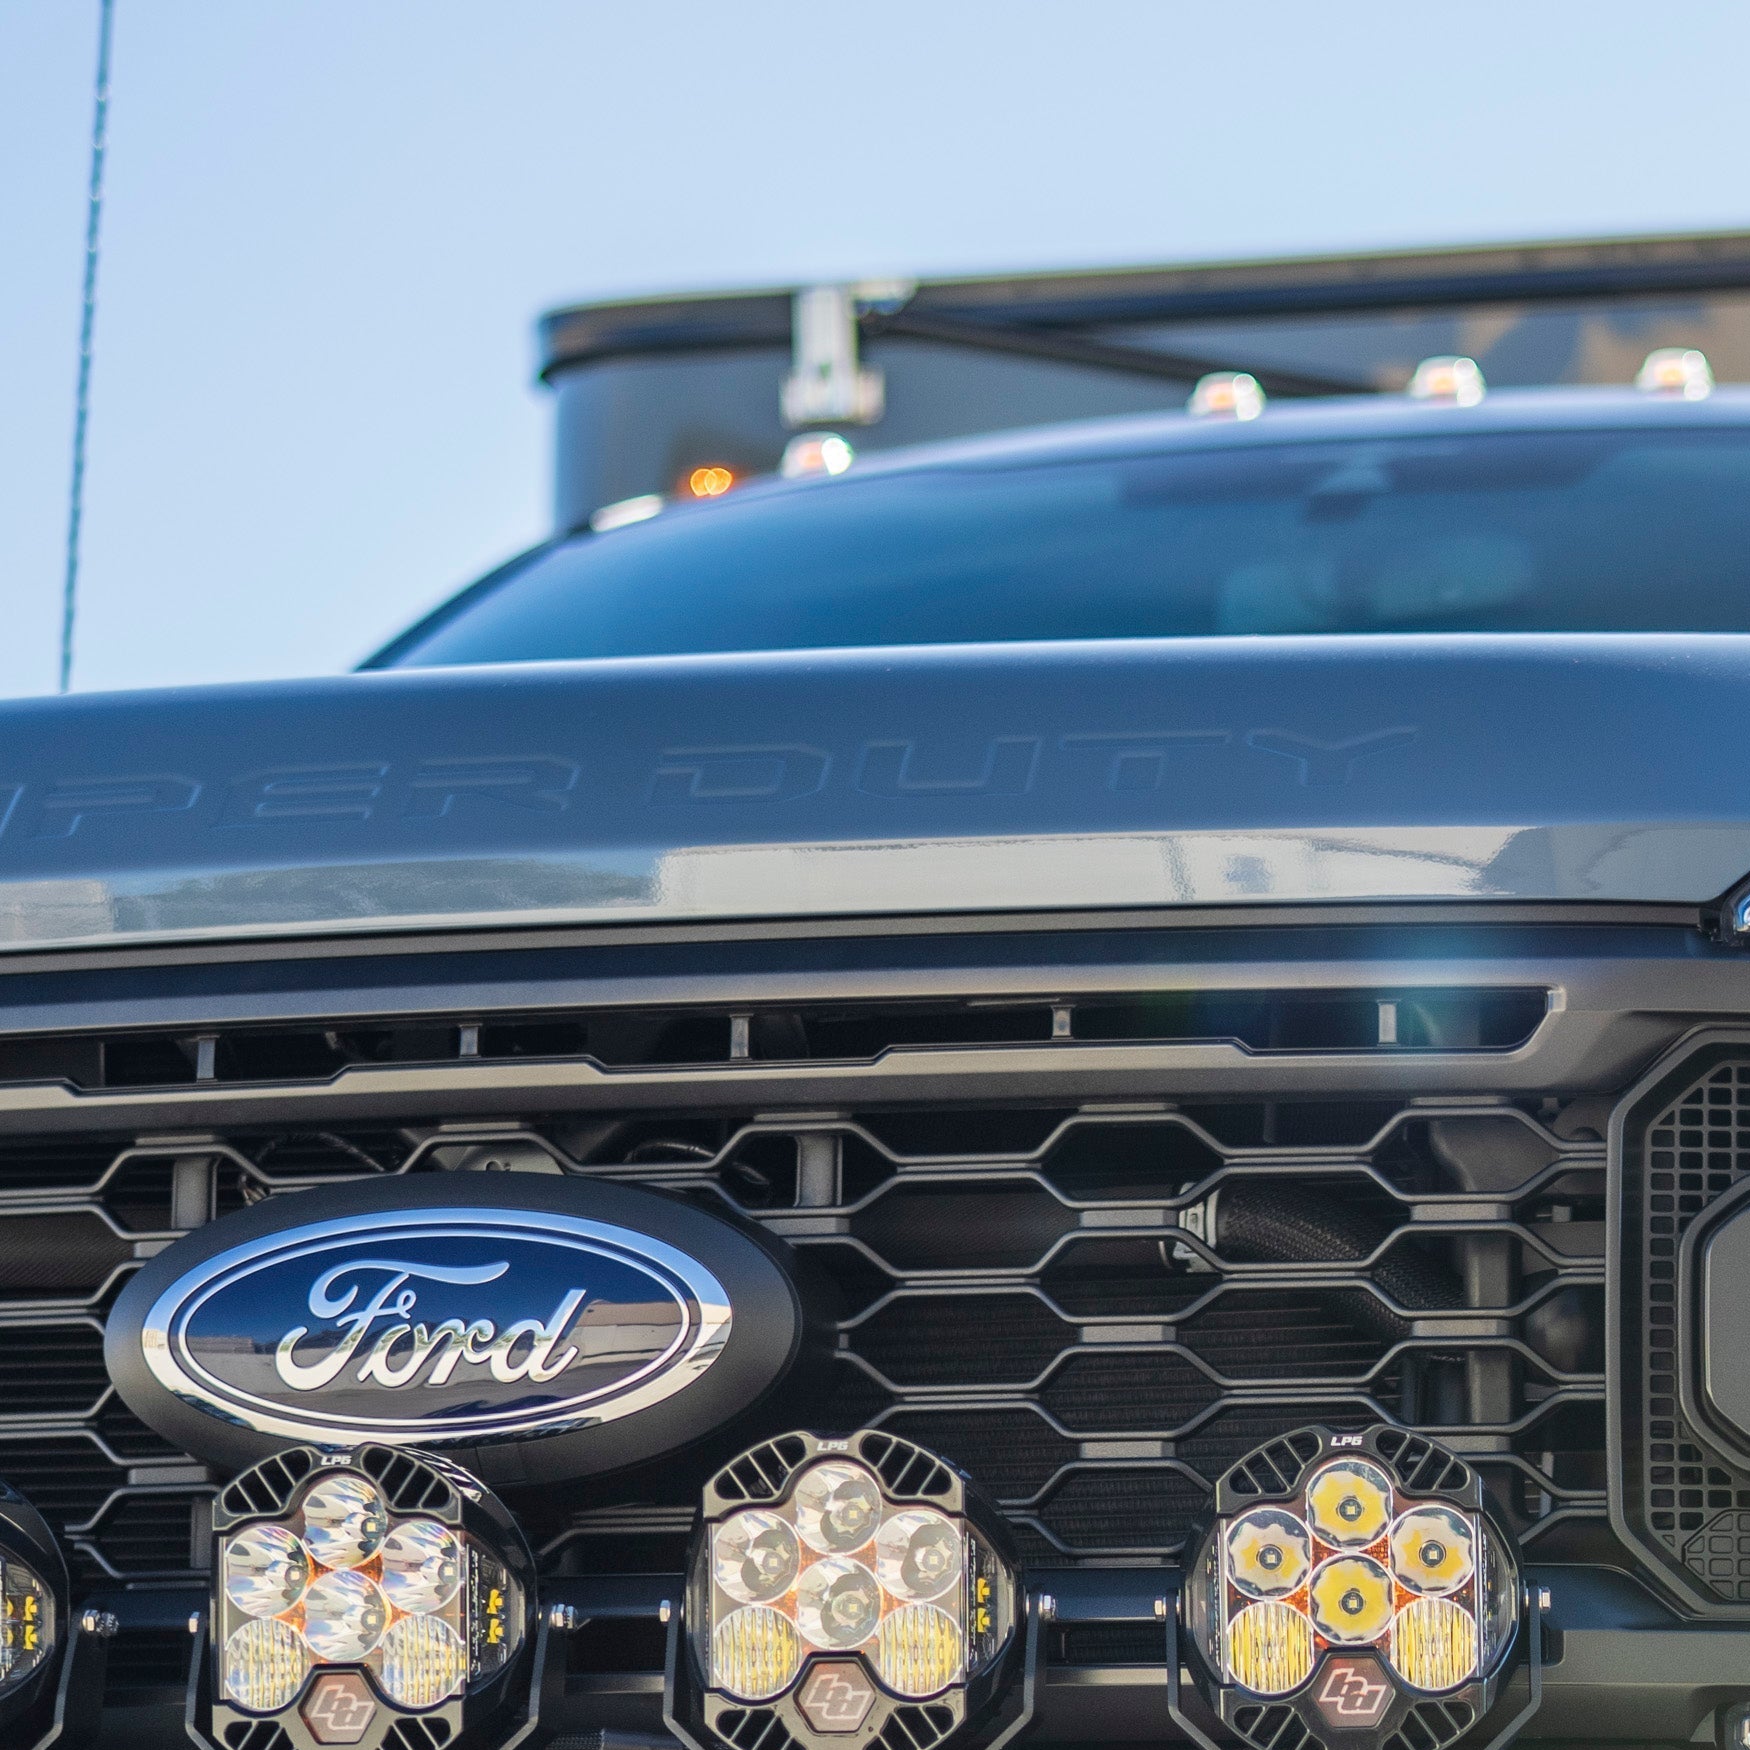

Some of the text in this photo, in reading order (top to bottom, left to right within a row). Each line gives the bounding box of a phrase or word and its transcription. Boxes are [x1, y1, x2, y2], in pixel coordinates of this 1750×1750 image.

[0, 726, 1420, 842] PER DUTY
[274, 1259, 588, 1391] Ford
